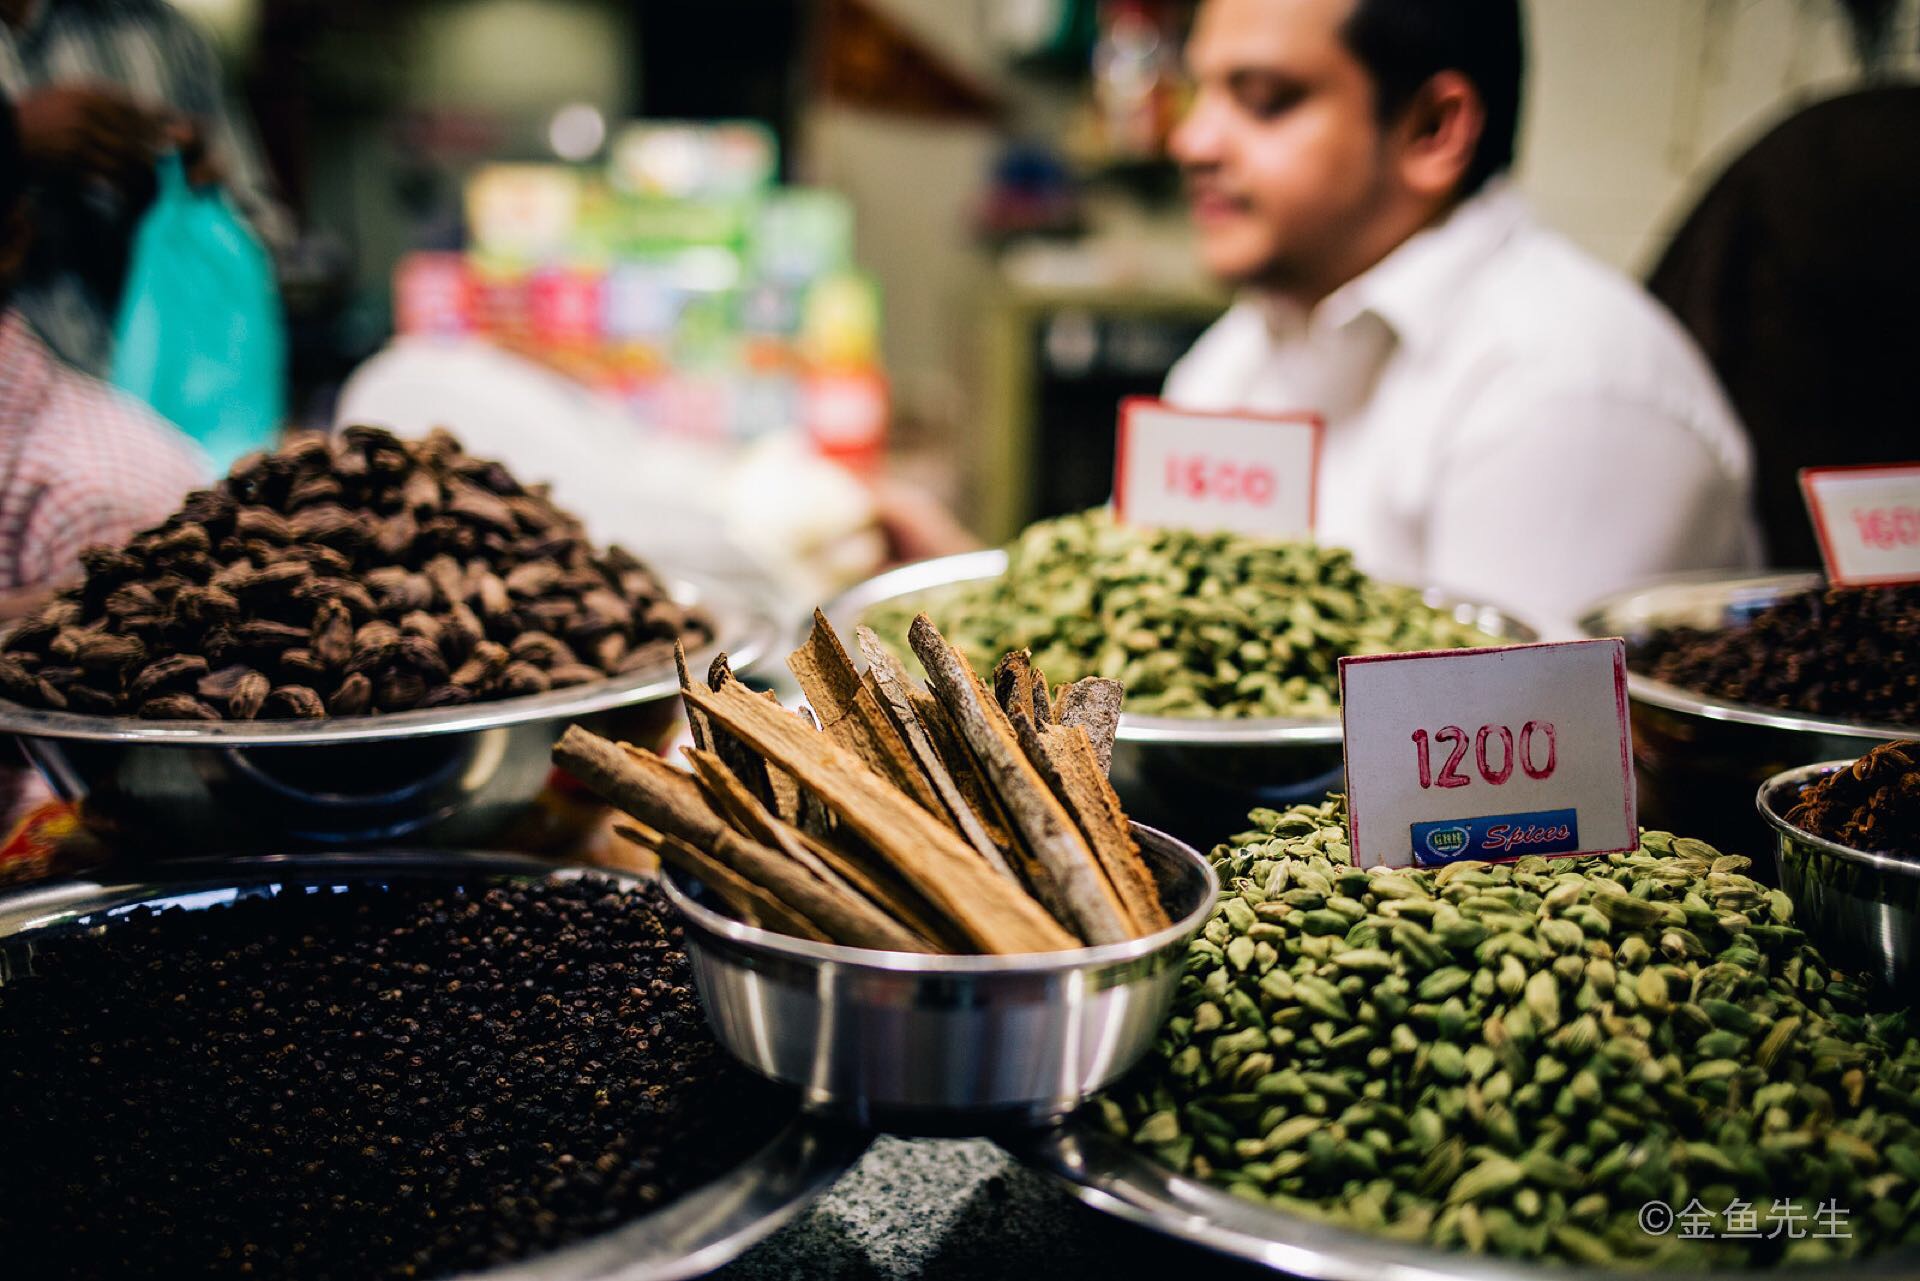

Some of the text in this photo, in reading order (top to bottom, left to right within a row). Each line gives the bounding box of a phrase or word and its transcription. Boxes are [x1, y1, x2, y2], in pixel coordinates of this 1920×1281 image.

[1853, 506, 1920, 550] 160
[1411, 719, 1557, 790] 1200
[1482, 824, 1571, 852] Spices
